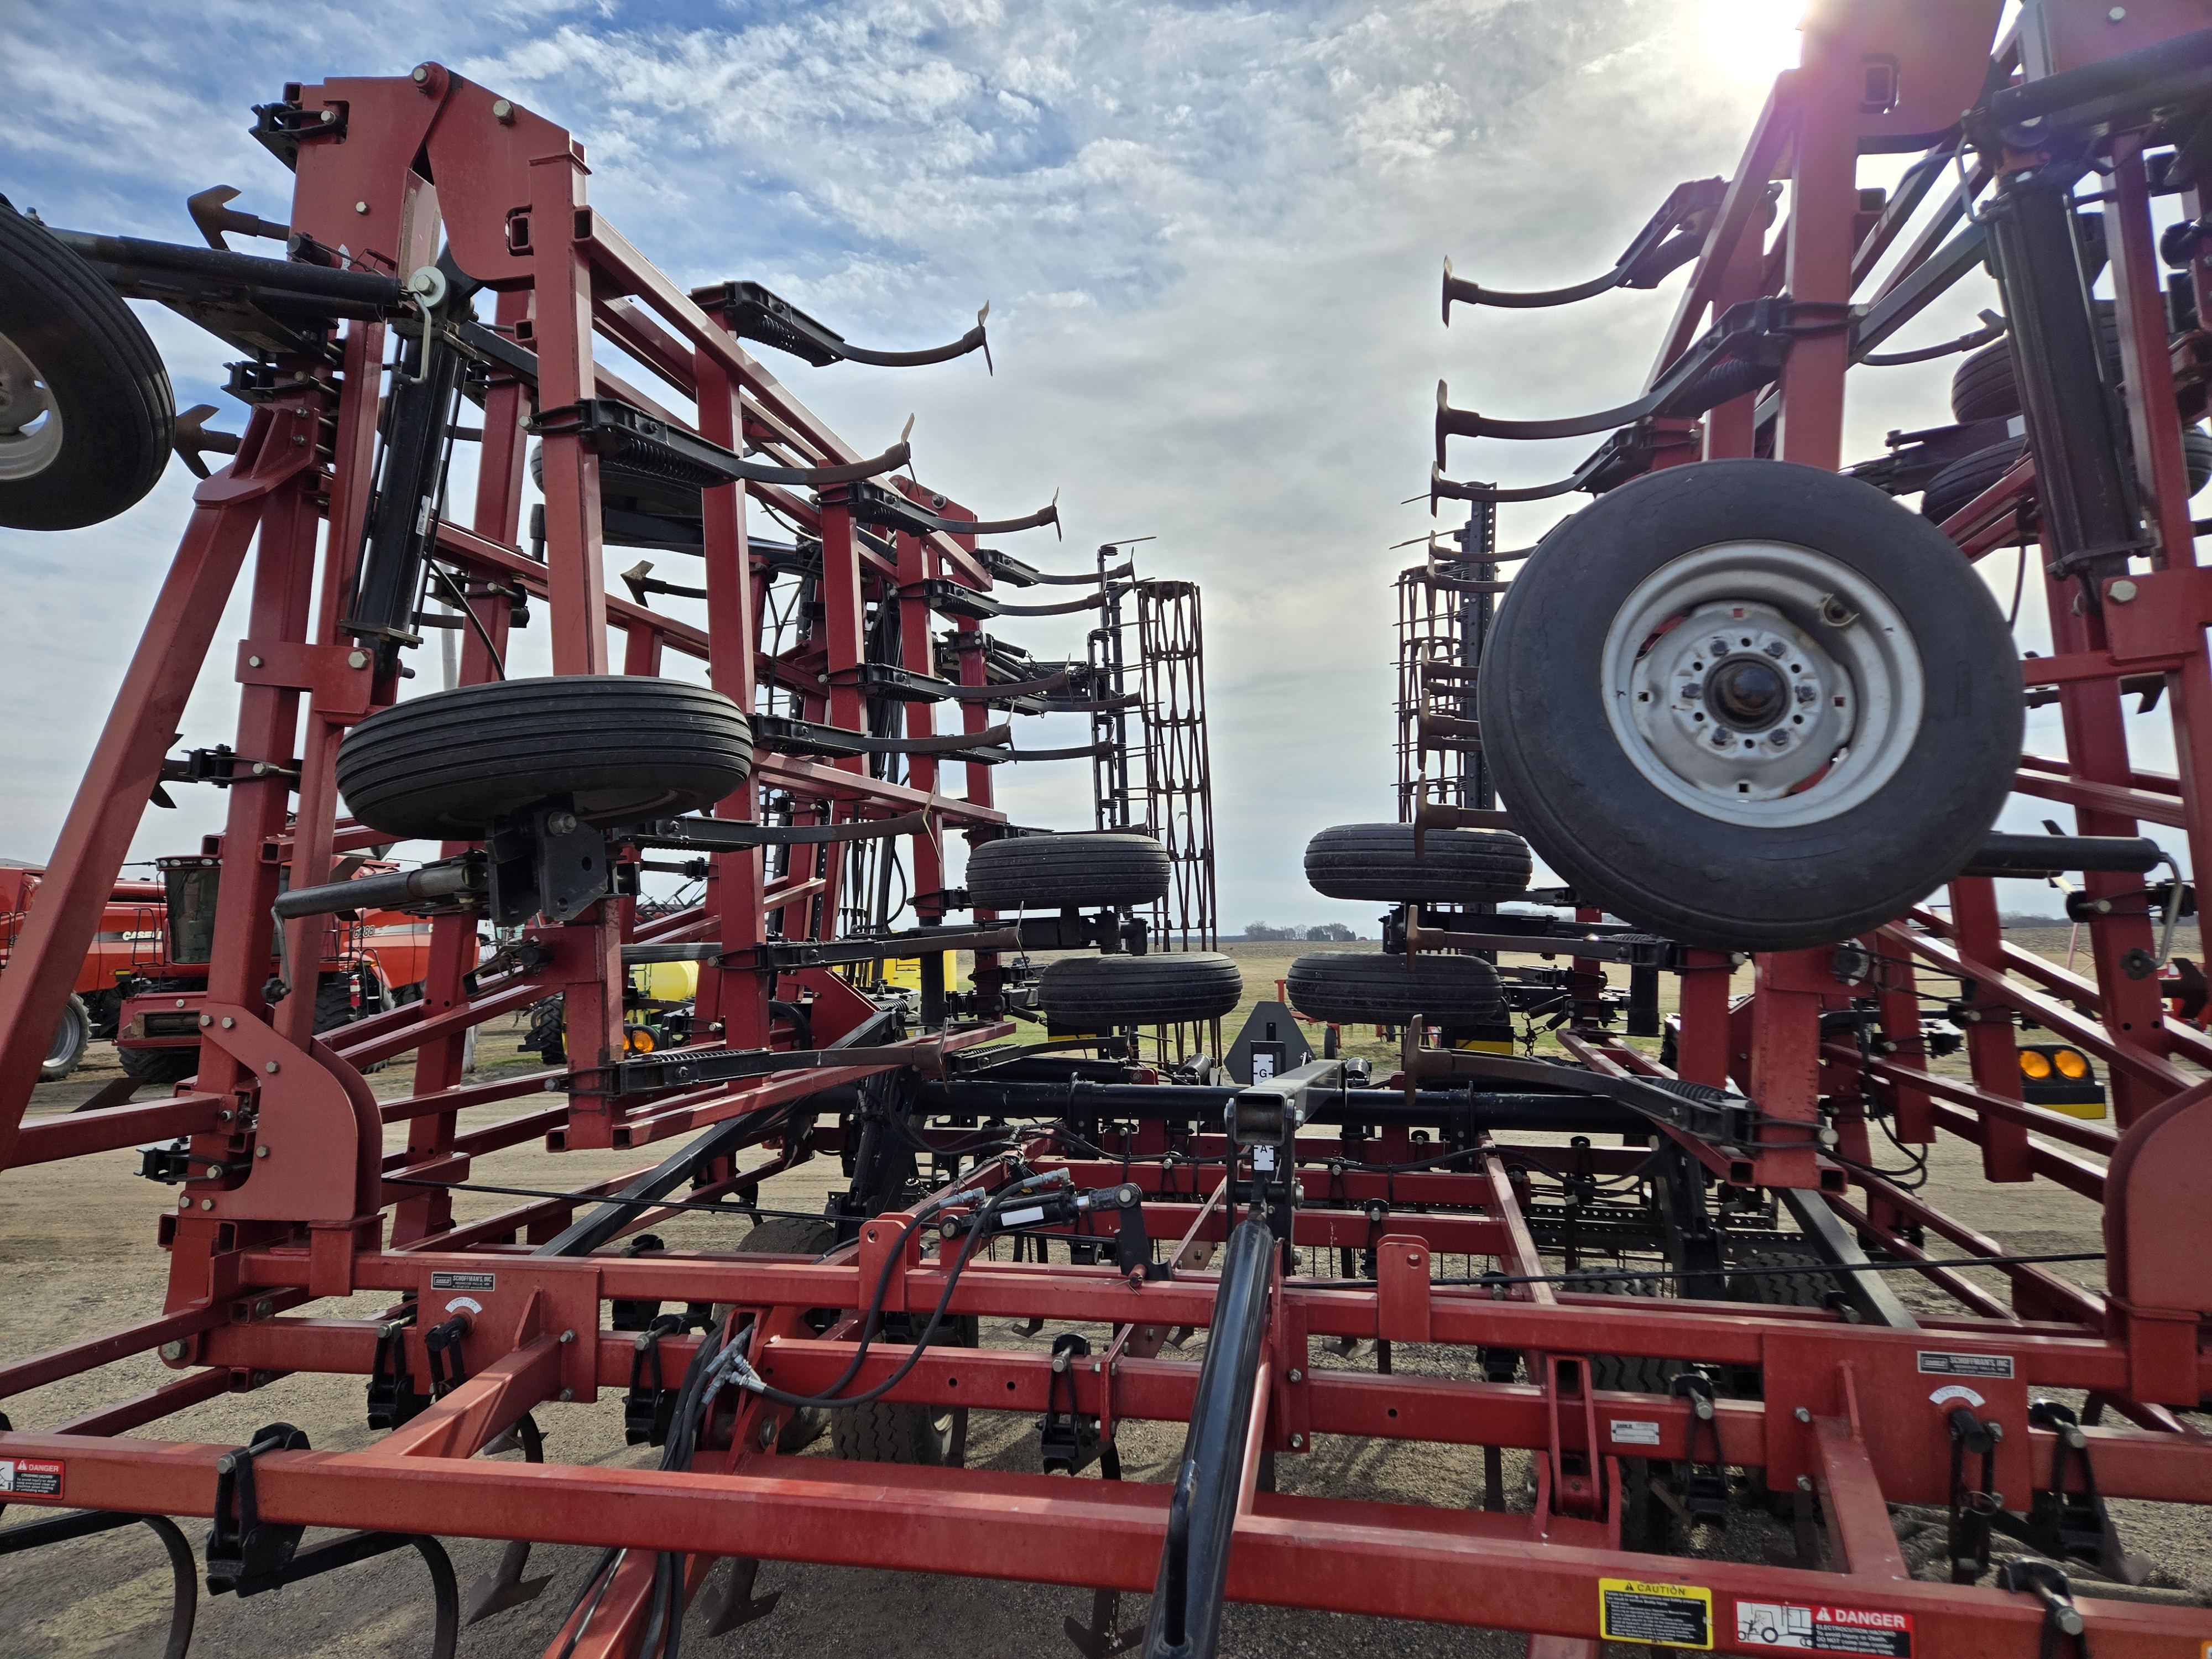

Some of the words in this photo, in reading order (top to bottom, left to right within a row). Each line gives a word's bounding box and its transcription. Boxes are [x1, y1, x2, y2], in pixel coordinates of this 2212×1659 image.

[122, 931, 152, 941] CASE
[1259, 1068, 1267, 1078] G
[1260, 1145, 1267, 1153] A
[29, 1464, 59, 1472] DANGER
[1637, 1584, 1686, 1595] CAUTION
[1835, 1609, 1906, 1629] DANGER
[1816, 1624, 1868, 1634] ELECTROCUTION
[1868, 1629, 1897, 1637] HAZARD
